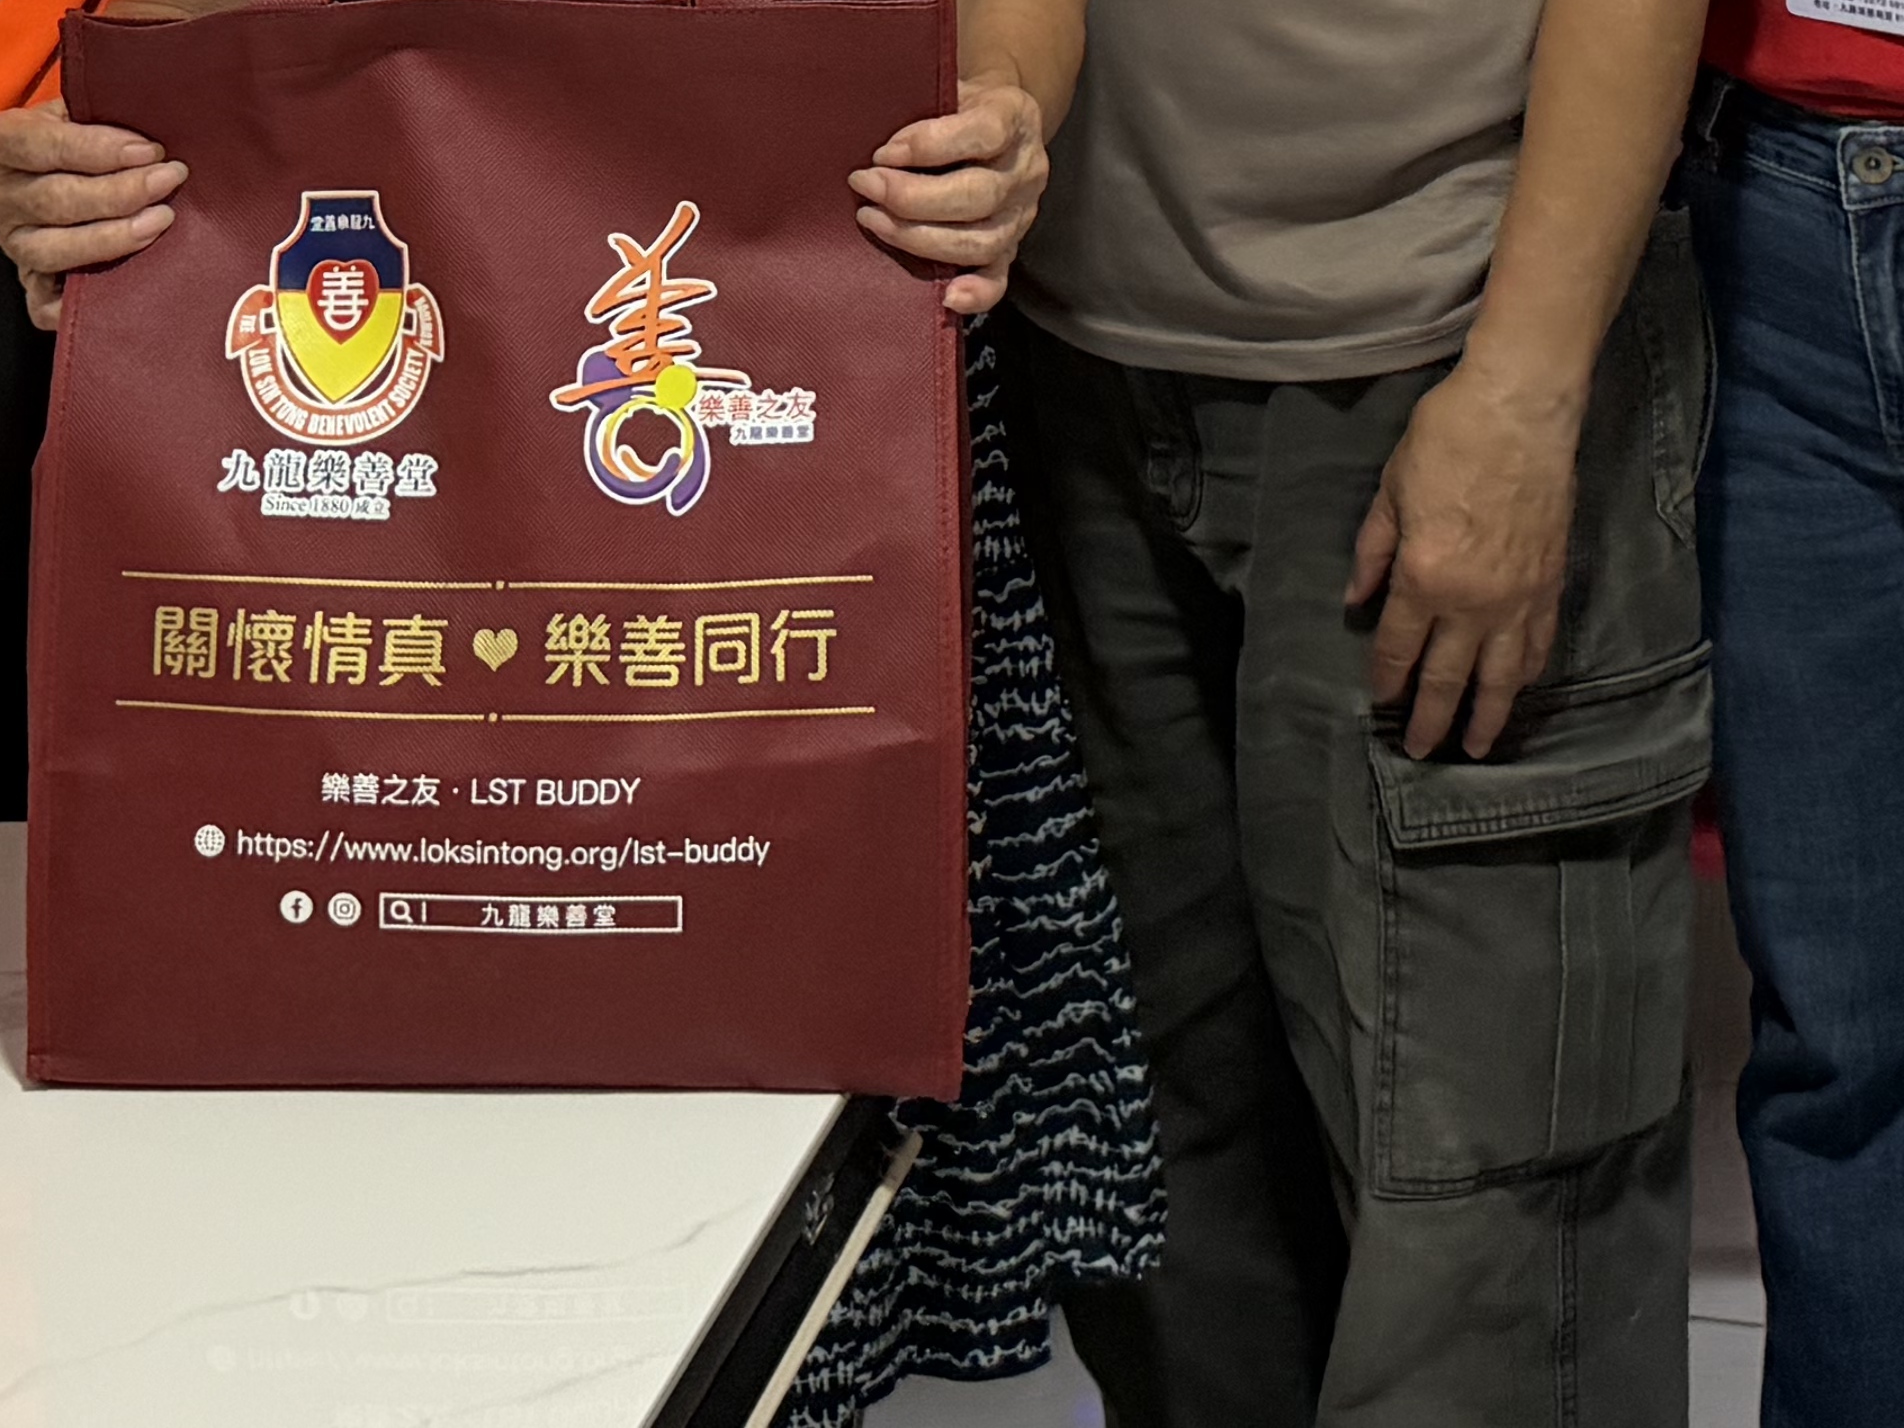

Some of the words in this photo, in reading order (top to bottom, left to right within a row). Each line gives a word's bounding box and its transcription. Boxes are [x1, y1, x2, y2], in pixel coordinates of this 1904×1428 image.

[249, 348, 272, 377] LOK
[389, 348, 427, 408] SOCIETY
[255, 375, 282, 405] SIN
[698, 391, 813, 423] 樂善之友
[270, 403, 308, 431] TONG
[307, 400, 397, 436] BENEVOLENT
[219, 450, 437, 495] 九龍樂善堂
[264, 495, 307, 513] Since
[311, 497, 349, 514] 1880
[153, 604, 449, 688] 關懷情真
[544, 608, 838, 689] 樂善同行
[321, 771, 441, 807] 樂善之友
[470, 778, 526, 806] LST
[536, 776, 641, 807] BUDDY
[237, 828, 771, 872] https://www.loksintong.org/lst-buddy
[480, 902, 618, 929] 九龍樂善堂
